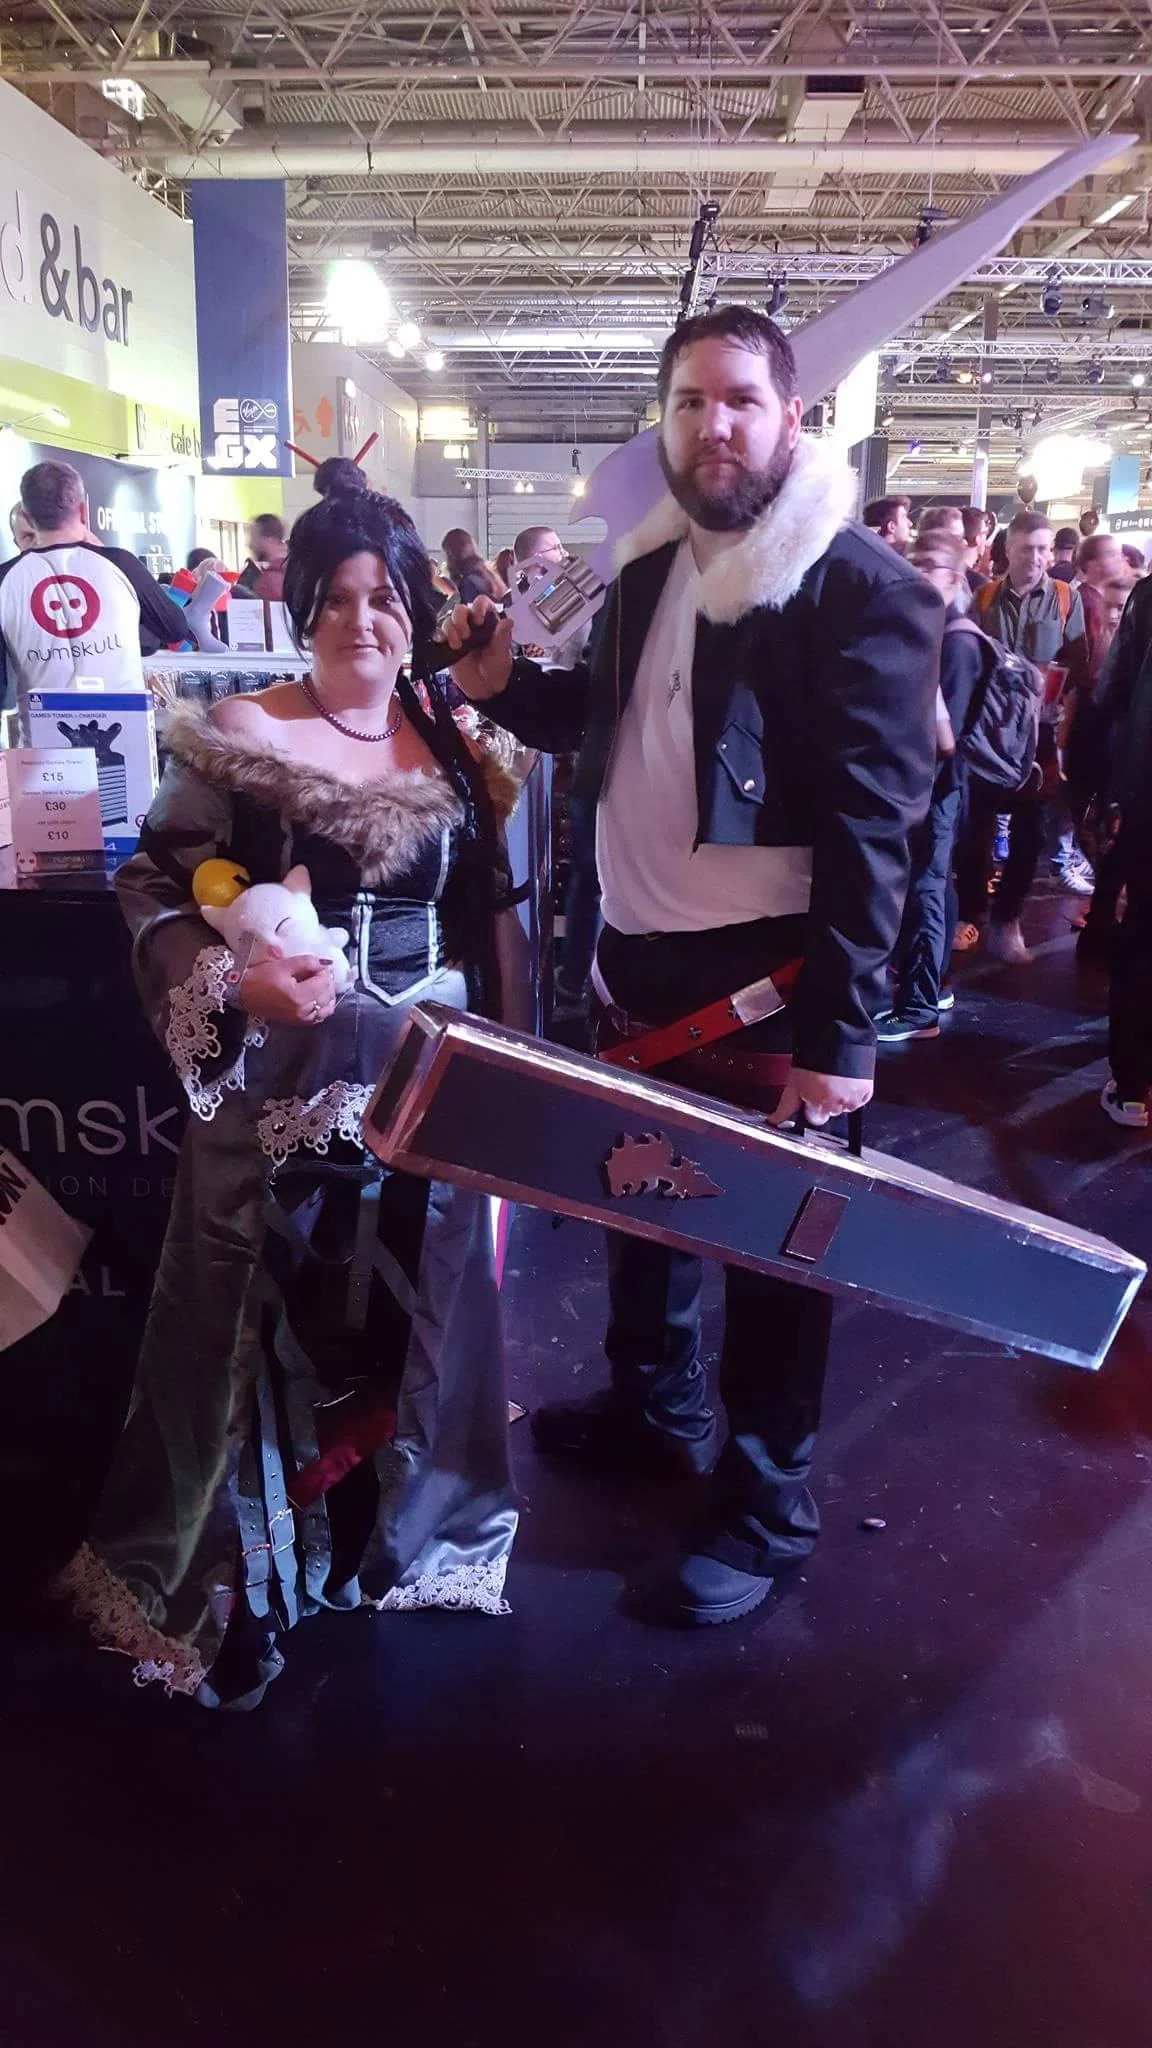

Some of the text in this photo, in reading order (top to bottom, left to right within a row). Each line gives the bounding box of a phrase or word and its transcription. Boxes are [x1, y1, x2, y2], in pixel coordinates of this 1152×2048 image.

[27, 633, 122, 661] numskull
[42, 772, 64, 782] £15
[45, 801, 66, 811] £30
[47, 831, 69, 840] £10
